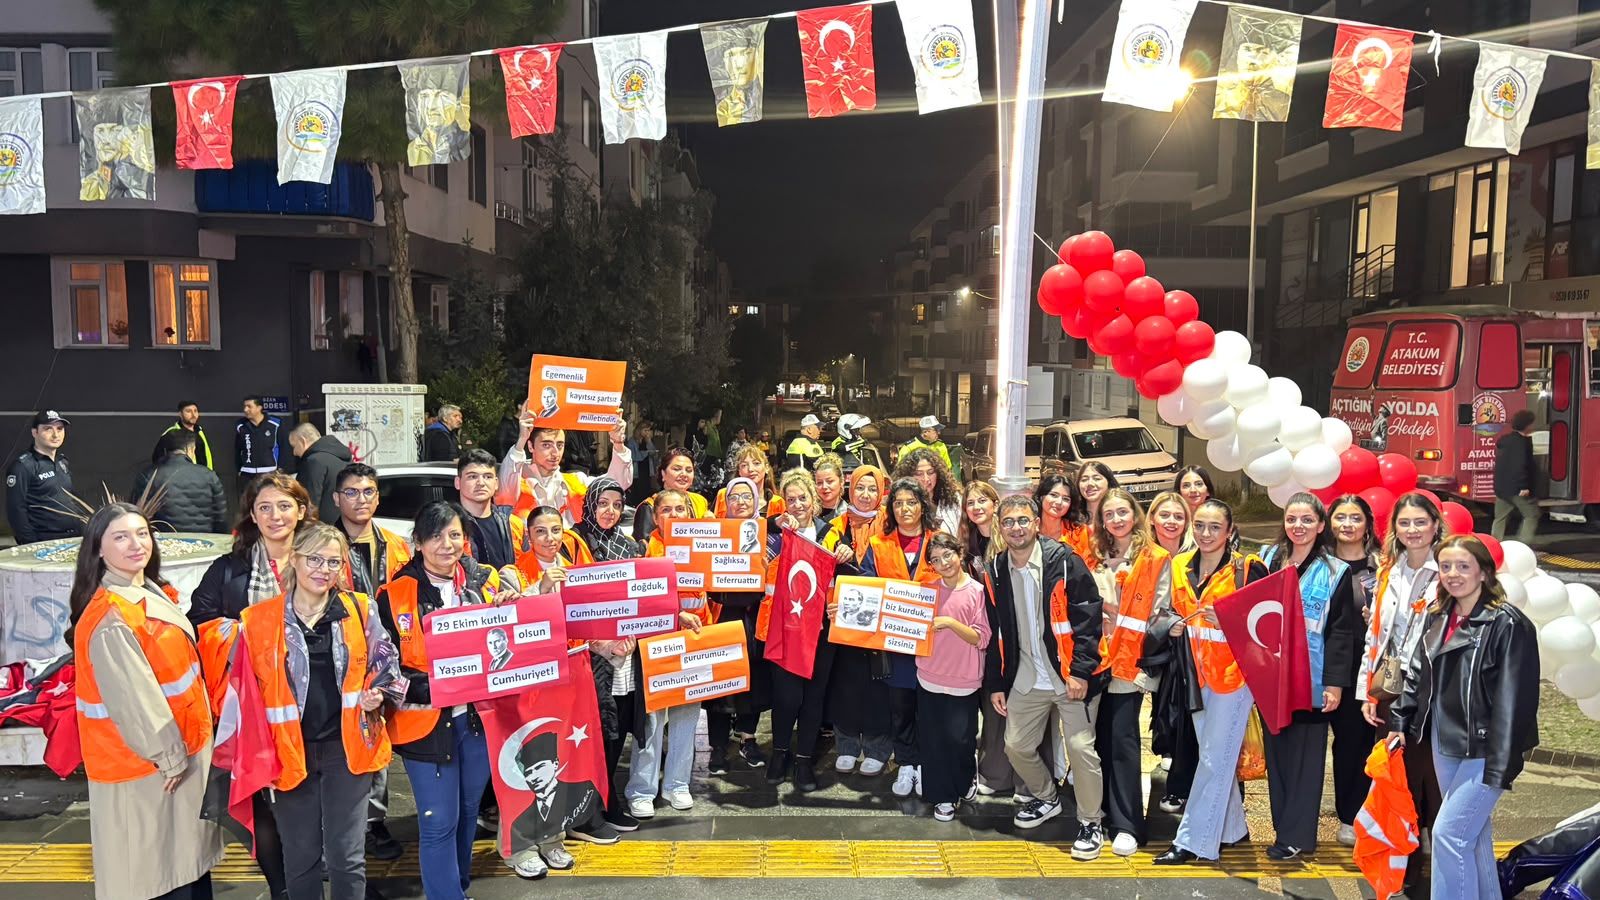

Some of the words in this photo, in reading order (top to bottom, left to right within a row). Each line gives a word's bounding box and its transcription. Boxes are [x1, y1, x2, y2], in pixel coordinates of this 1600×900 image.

[1408, 332, 1428, 343] T.C.
[1390, 348, 1440, 360] ATAKUM
[1382, 361, 1445, 376] BELEDİYESİ
[545, 370, 584, 381] Egemenlik
[569, 392, 596, 401] kayıtsız
[1332, 396, 1372, 414] AÇTIĞIN
[1386, 401, 1440, 416] YOLDA
[1387, 417, 1435, 440] Hedefe
[1468, 450, 1496, 458] ATAK
[1461, 459, 1496, 471] BELEDİ
[714, 556, 747, 566] Sağlıksa,
[568, 570, 628, 583] Cumhuriyetle
[678, 577, 702, 585] Gerisi
[631, 582, 665, 592] doğduk,
[888, 586, 935, 602] Cumhuriyeti
[570, 606, 630, 618] Cumhuriyetle
[886, 602, 896, 610] biz
[898, 606, 927, 618] kurduk,
[436, 622, 450, 632] 29
[453, 618, 478, 630] Ekim
[481, 614, 508, 626] kutlu
[620, 619, 670, 632] yaşayacağız
[884, 622, 922, 636] yaşatacak
[518, 628, 546, 639] olsun
[652, 646, 662, 654] 29
[664, 644, 684, 652] Ekim
[888, 638, 914, 650] sizsiniz
[684, 650, 729, 664] gururumuz,
[439, 664, 478, 676] Yaşasın
[492, 666, 554, 686] Cumhuriyet!
[652, 674, 698, 688] Cumhuriyet
[688, 680, 740, 696] onurumuzdur
